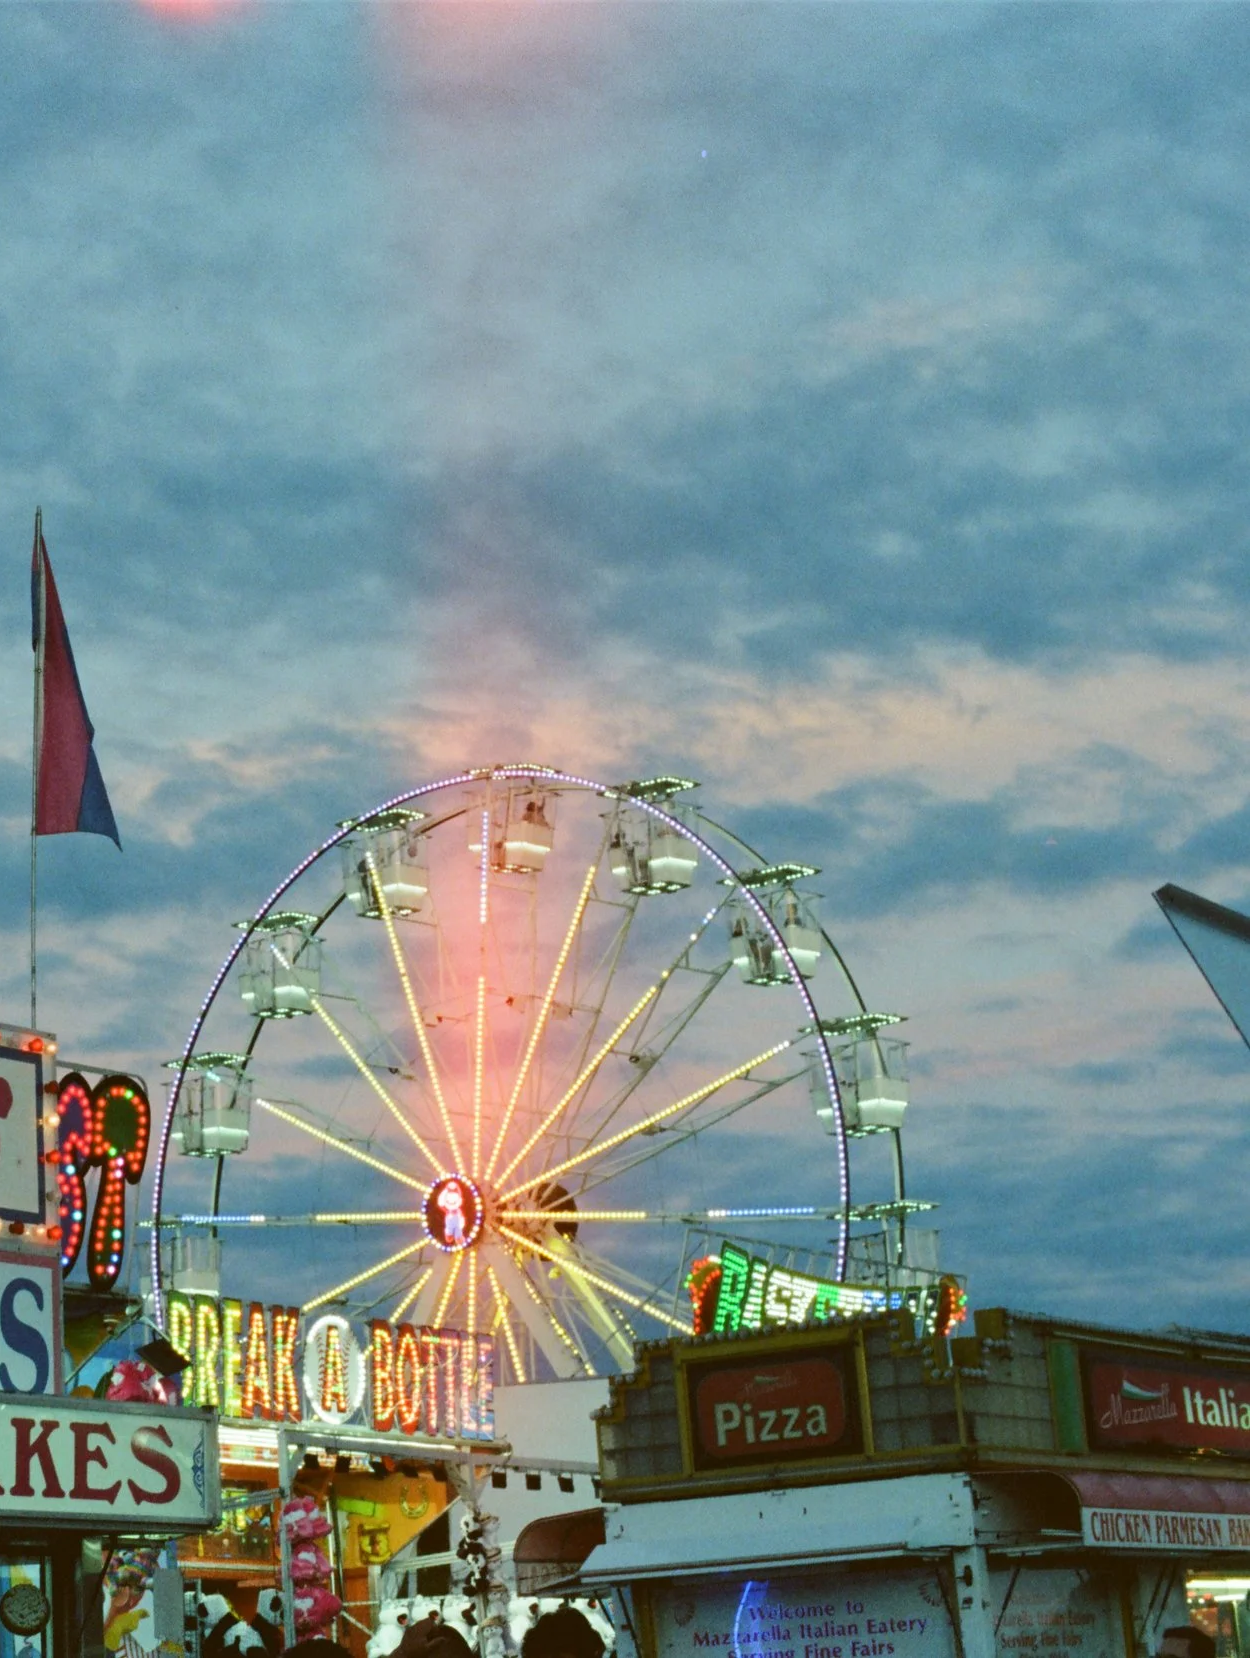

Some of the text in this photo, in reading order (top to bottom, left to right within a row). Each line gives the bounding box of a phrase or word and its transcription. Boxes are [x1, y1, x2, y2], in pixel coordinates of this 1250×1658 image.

[168, 1290, 496, 1442] BREAK A BOTTLE
[714, 1402, 828, 1447] Pizza
[1182, 1386, 1250, 1430] Italia
[1090, 1511, 1152, 1543] CHICKEN
[1155, 1514, 1223, 1547] PARMESAN
[749, 1600, 865, 1621] Welcome to
[693, 1617, 928, 1648] Mazarella Italian Eatery
[805, 1642, 842, 1658] Fine
[851, 1639, 895, 1657] Fairs
